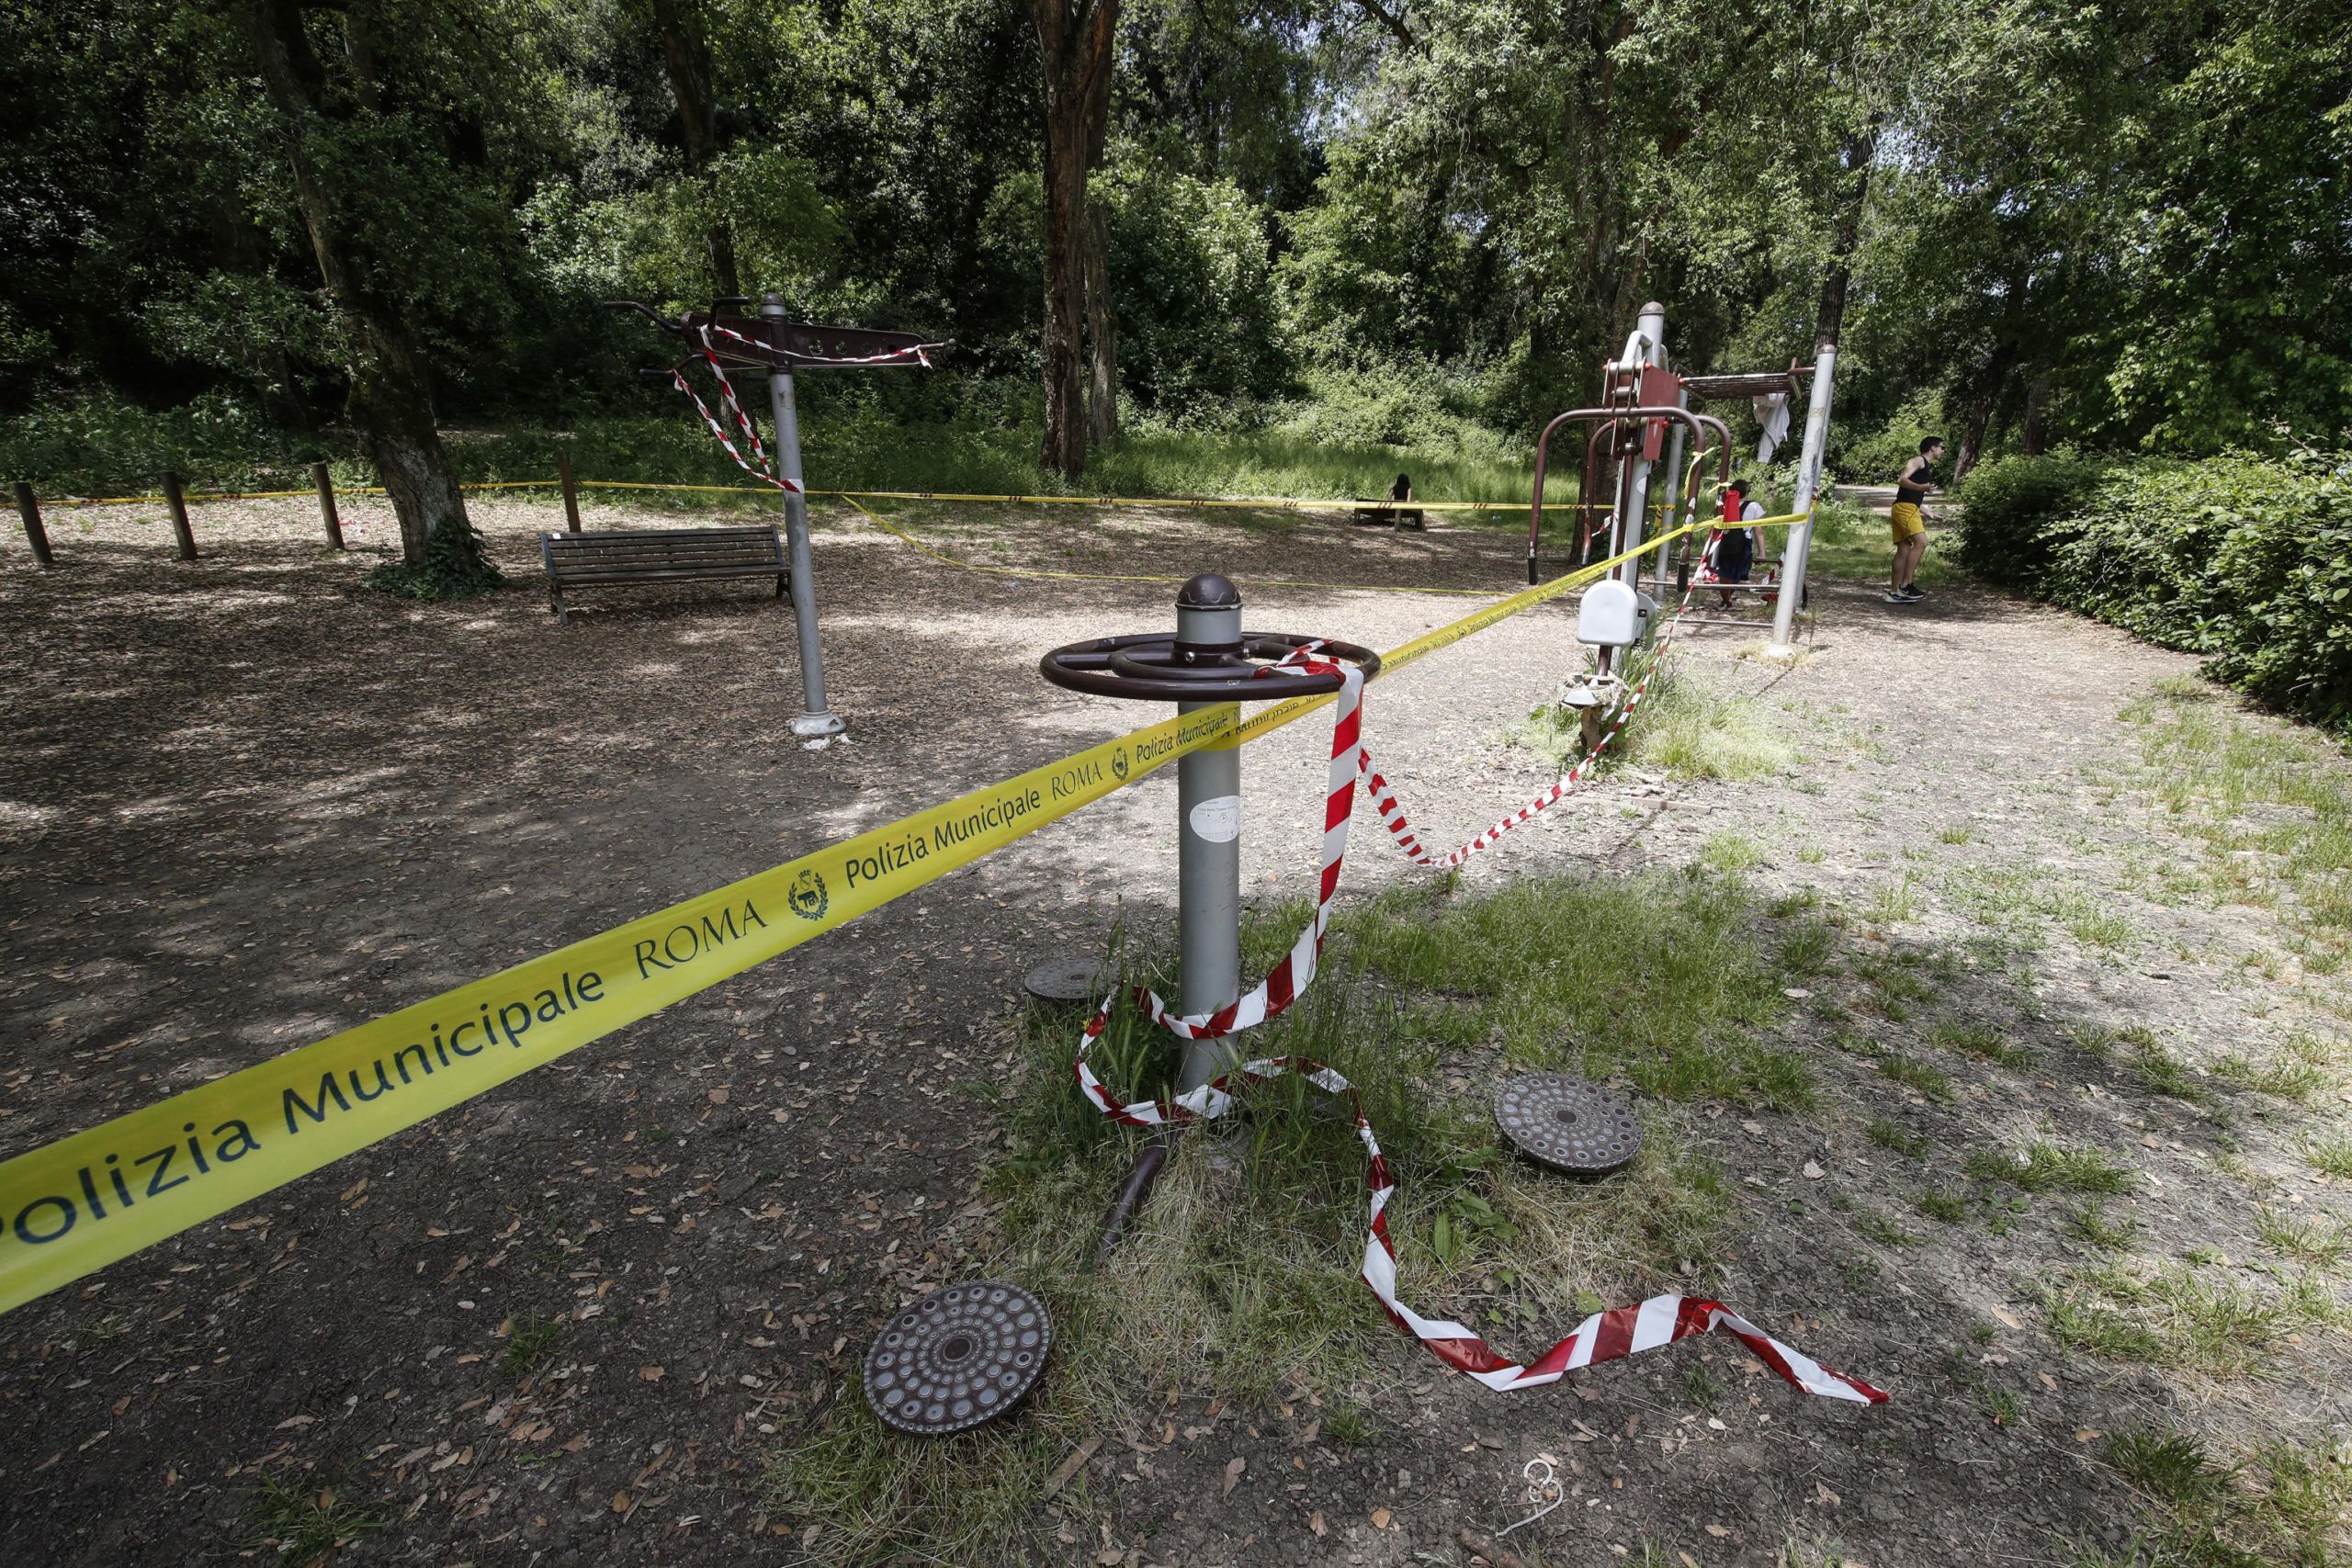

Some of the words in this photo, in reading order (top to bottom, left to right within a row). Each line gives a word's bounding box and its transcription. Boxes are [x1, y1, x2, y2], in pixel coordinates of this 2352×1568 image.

[1136, 730, 1174, 764] Polizia
[1175, 712, 1228, 747] Municipale
[845, 834, 928, 889] Polizia
[933, 787, 1041, 852] Municipale
[1051, 760, 1103, 802] ROMA
[0, 1118, 262, 1246] olizia
[281, 969, 605, 1134] Municipale
[632, 897, 769, 980] ROMA
